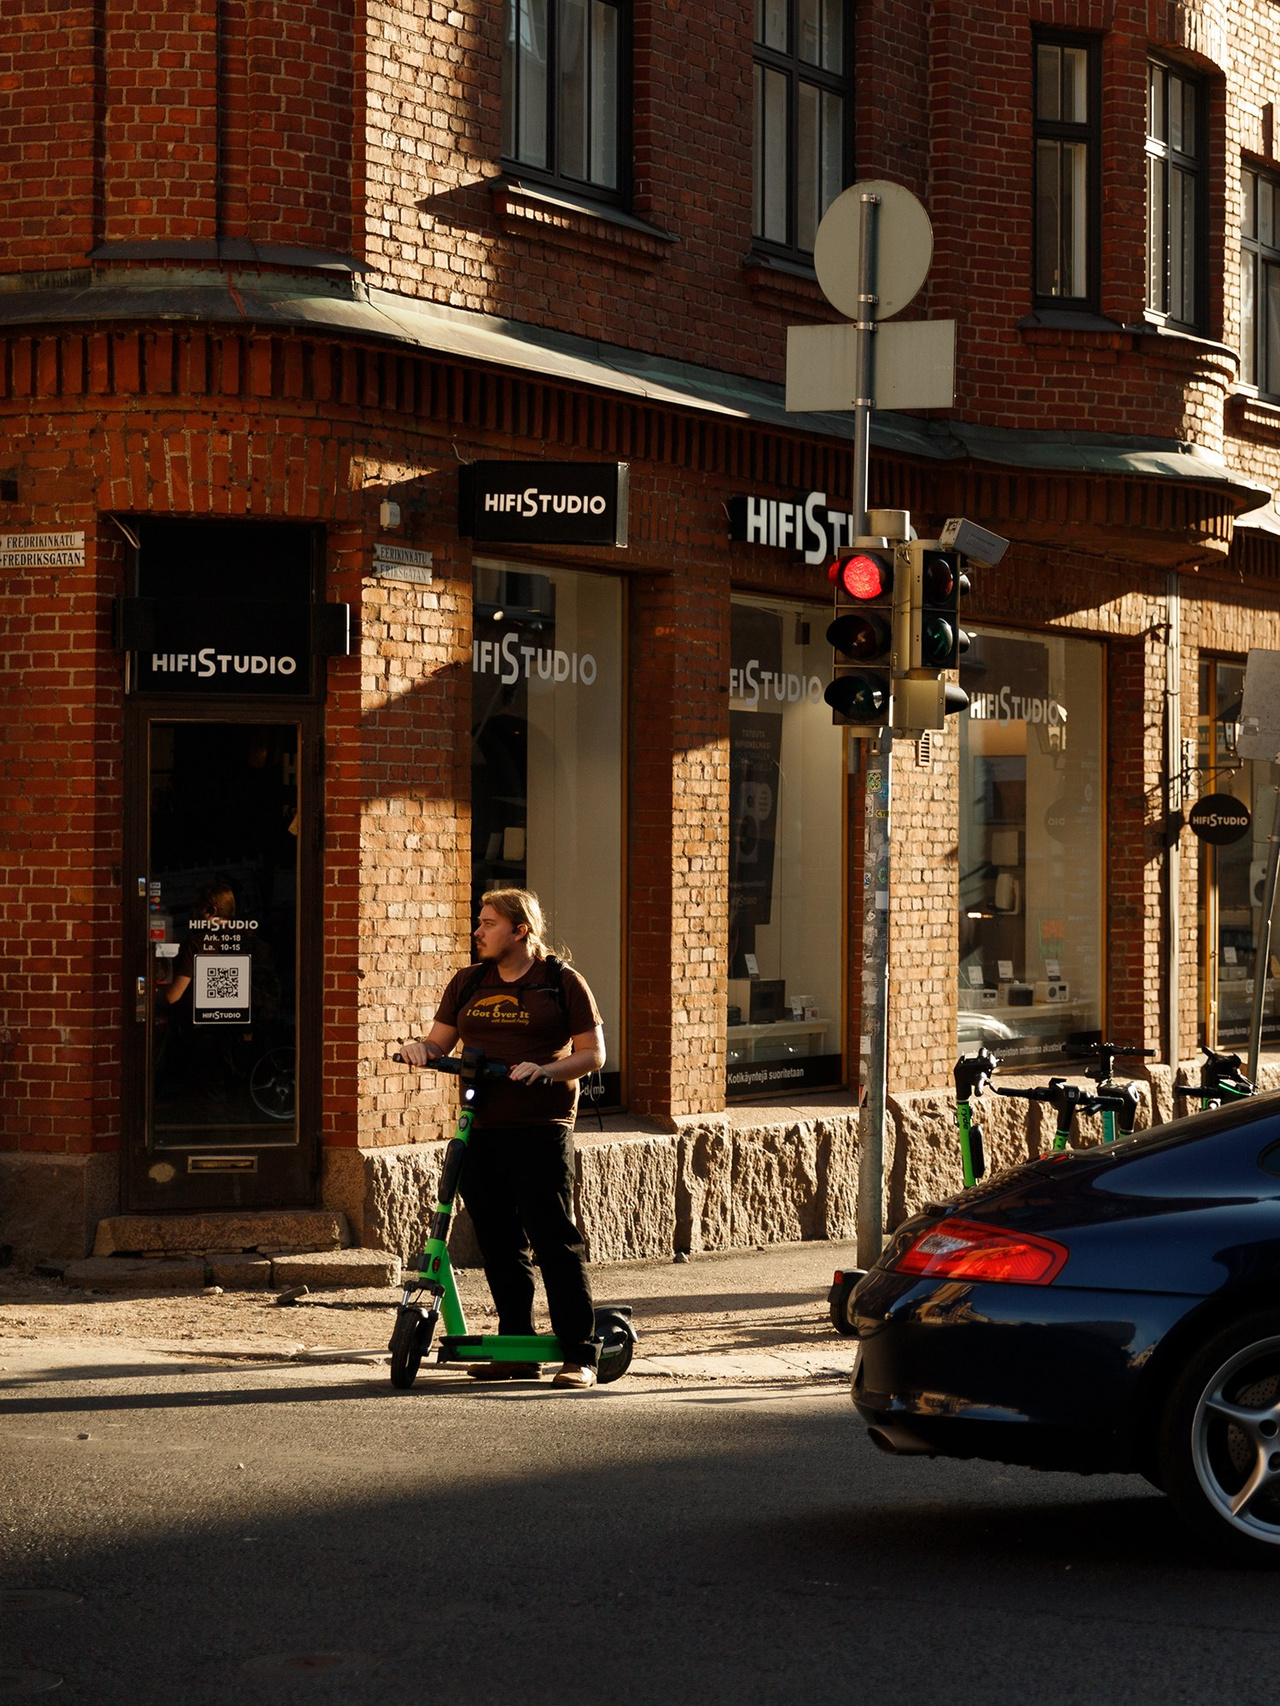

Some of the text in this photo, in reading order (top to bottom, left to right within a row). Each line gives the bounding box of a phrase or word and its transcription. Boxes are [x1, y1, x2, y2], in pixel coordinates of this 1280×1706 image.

[485, 487, 606, 517] HIFISTUDIO
[747, 491, 917, 565] HIFIST
[7, 534, 76, 549] FREDRIKINKATU
[2, 552, 81, 566] FREDRIKSGATAN
[380, 546, 427, 564] EERIKINKATU
[380, 564, 427, 581] ERIKSGATAN
[152, 648, 297, 677] HIFISTUDIO
[472, 632, 597, 686] IFISTUDIO
[729, 659, 823, 707] FISTUDIO
[970, 685, 1059, 727] HIFISTUDIO
[1192, 813, 1248, 827] HIFISTUDIO
[189, 917, 258, 931] HIFISTUDIO
[202, 1011, 241, 1020] HIFISTUDIO
[466, 1009, 472, 1017] I
[472, 1009, 491, 1018] Got
[727, 1068, 805, 1085] Kotikäyntejä suoritetaan
[584, 1085, 605, 1097] dmo
[961, 1108, 969, 1129] ryde
